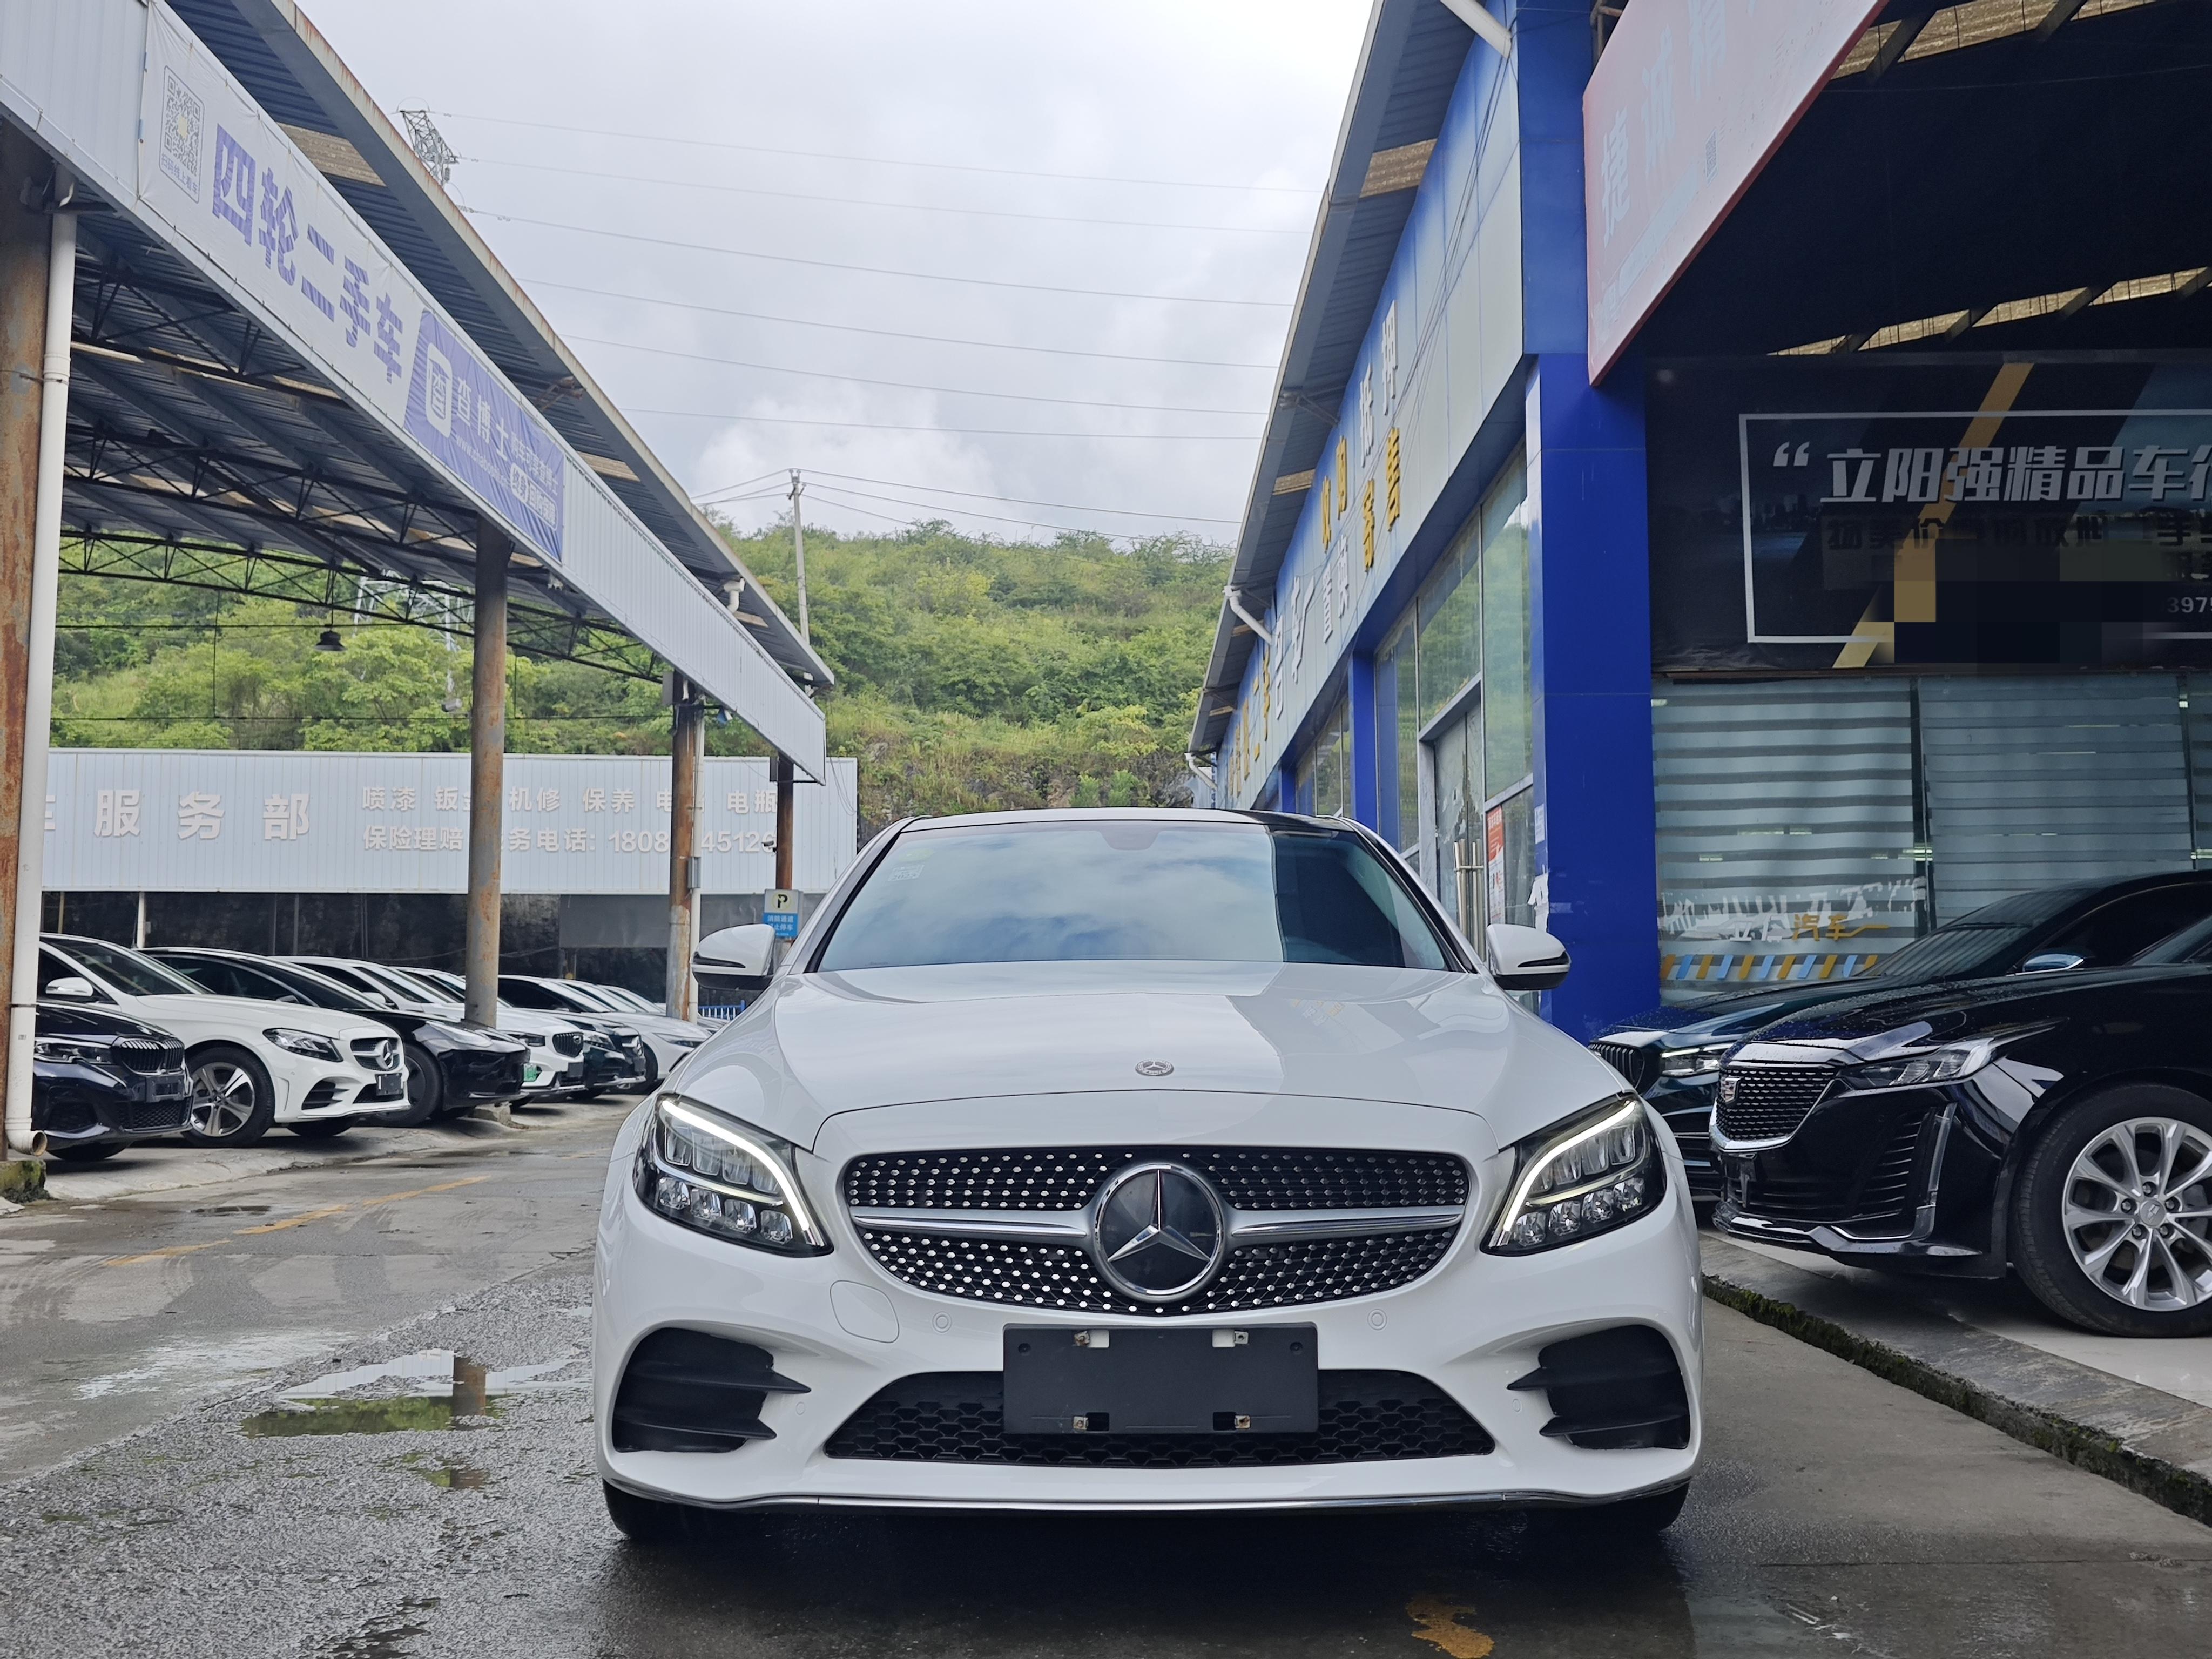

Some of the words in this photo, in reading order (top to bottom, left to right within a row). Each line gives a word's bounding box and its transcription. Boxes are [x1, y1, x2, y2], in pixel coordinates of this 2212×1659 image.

[212, 124, 403, 384] 四轮二手车
[1359, 300, 1399, 468] 抵押
[456, 376, 509, 462] 查博士
[2167, 596, 2212, 613] 397
[362, 786, 415, 811] 喷漆
[435, 786, 471, 811] 钣
[509, 786, 561, 812] 机修
[583, 787, 635, 814] 保养
[727, 790, 777, 814] 电瓶
[363, 825, 463, 851] 保险理赔
[501, 826, 595, 852] 务电话:
[608, 830, 777, 853] 180845126
